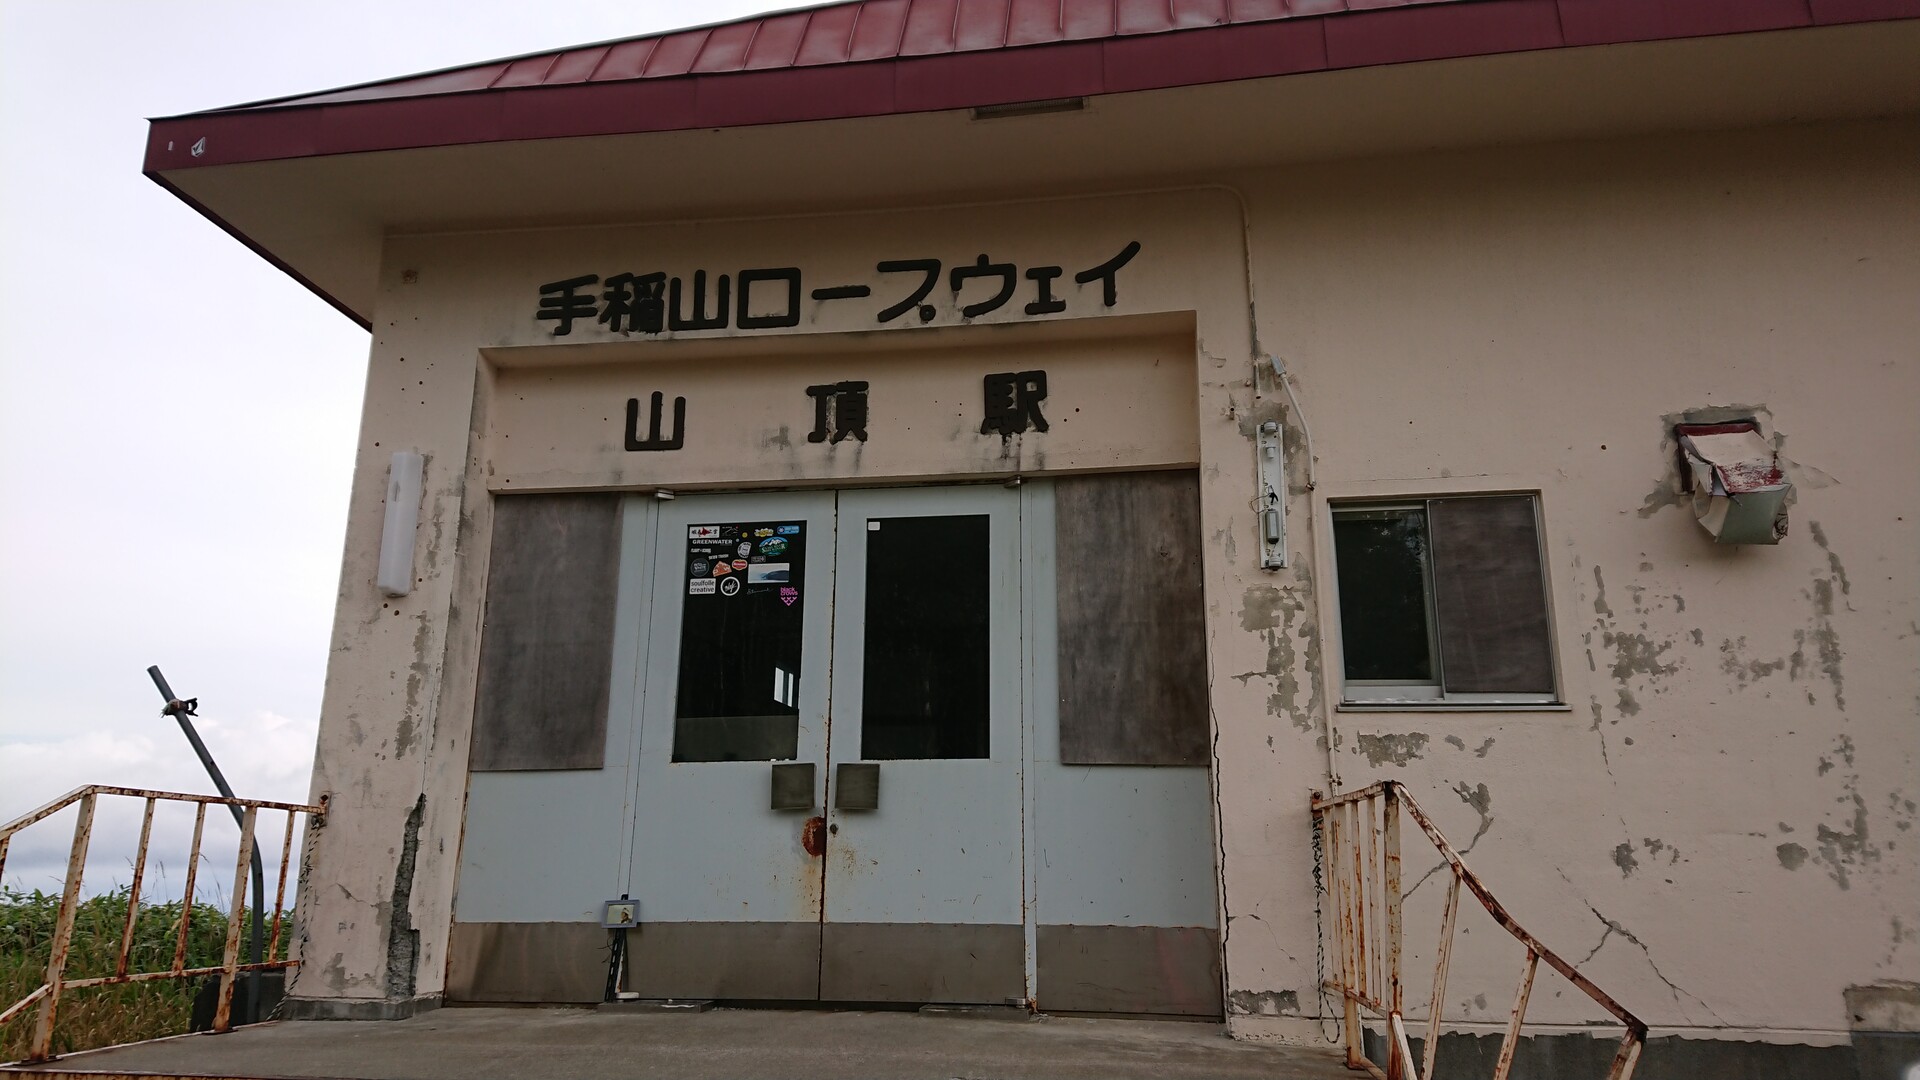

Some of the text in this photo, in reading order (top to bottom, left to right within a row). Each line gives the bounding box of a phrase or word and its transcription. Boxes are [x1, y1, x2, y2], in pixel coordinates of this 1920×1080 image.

[537, 241, 1141, 336] 手稲山ロープウェイ
